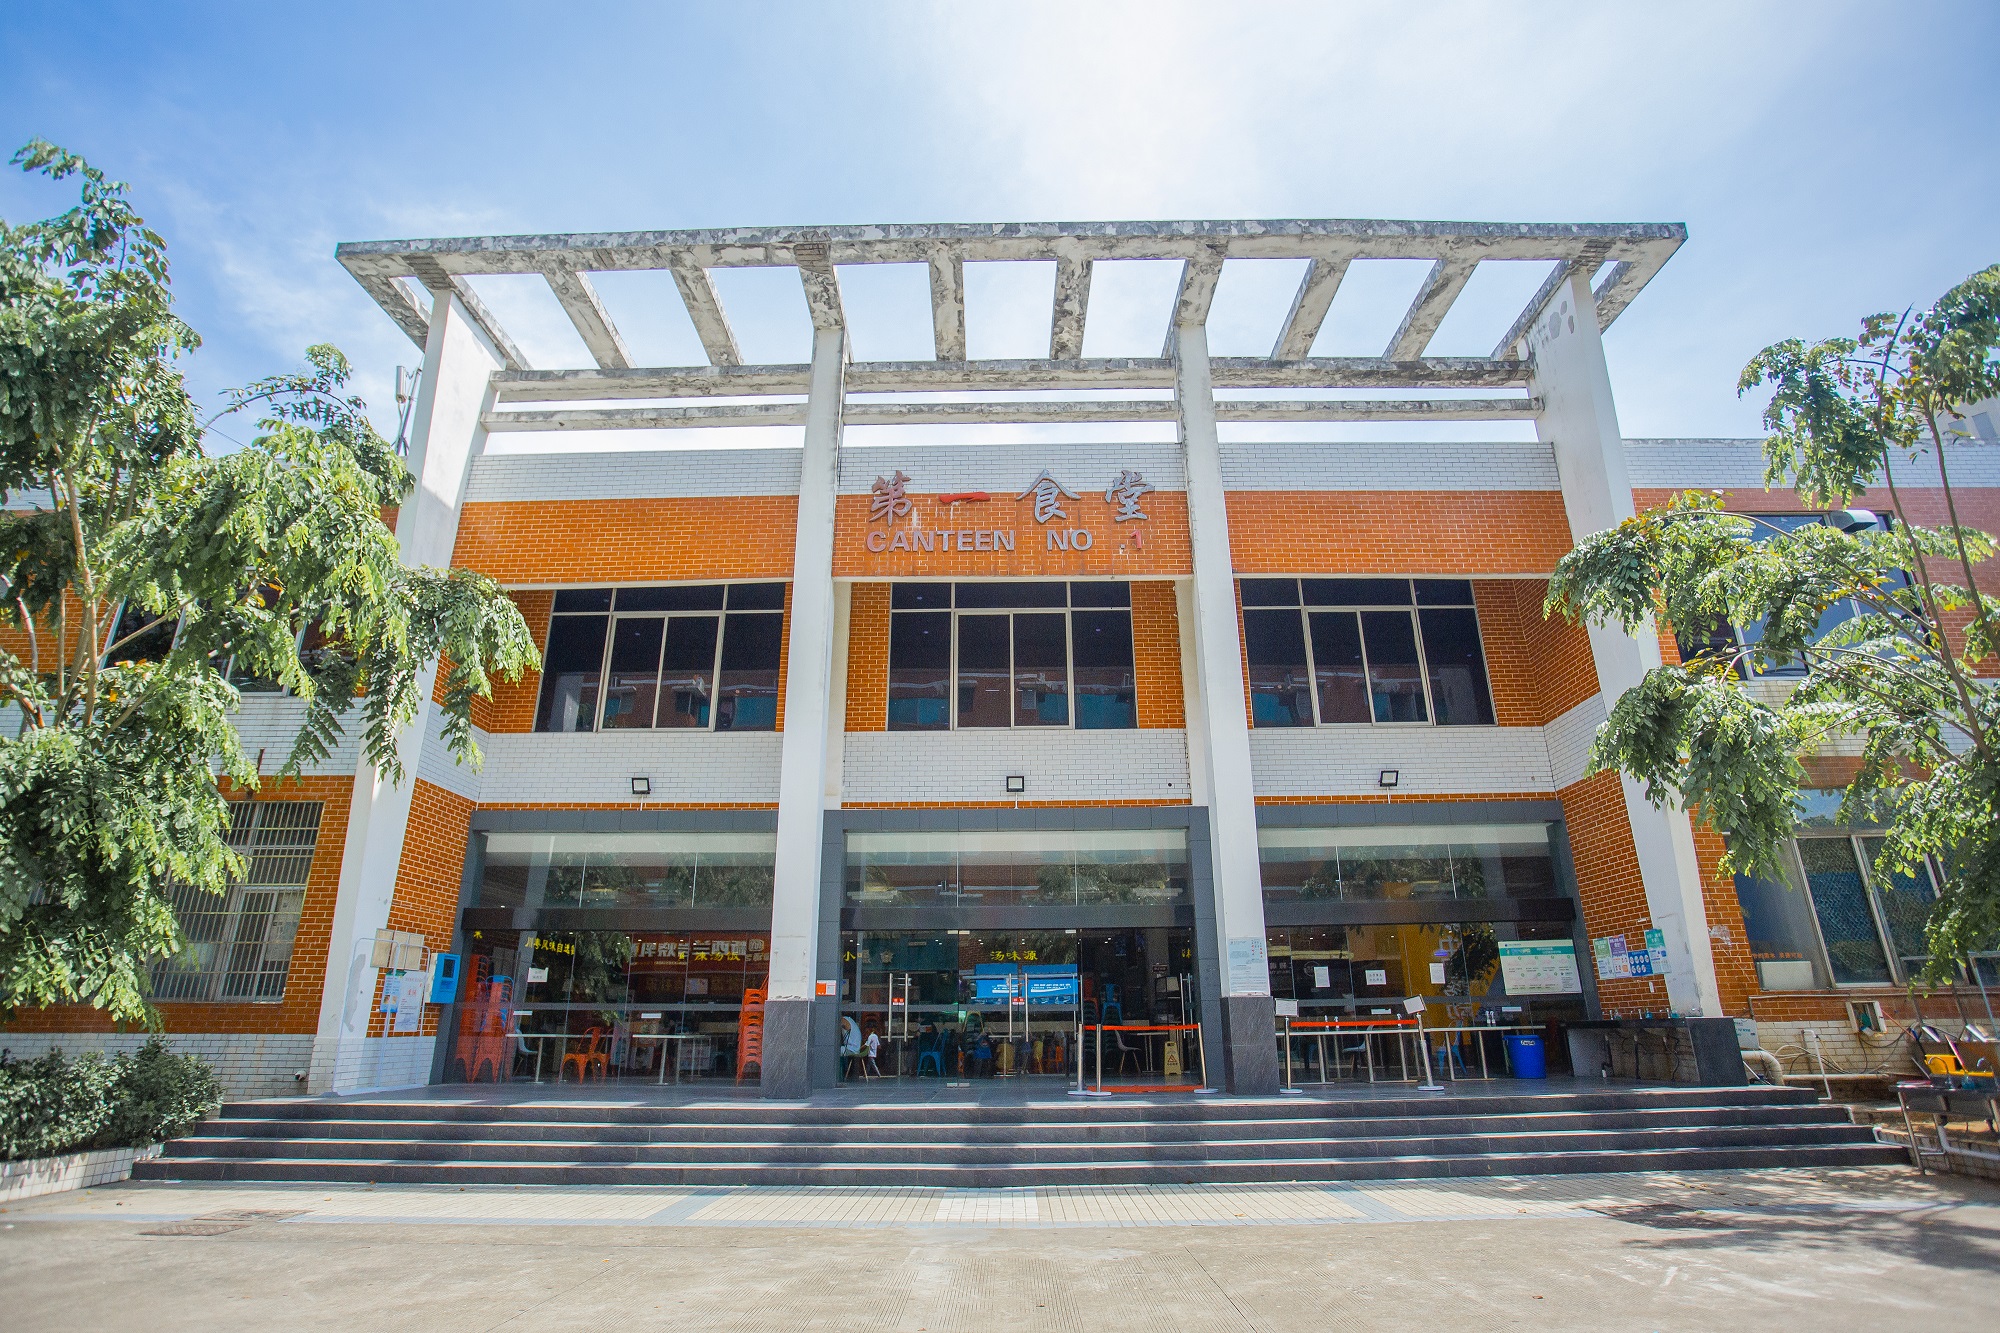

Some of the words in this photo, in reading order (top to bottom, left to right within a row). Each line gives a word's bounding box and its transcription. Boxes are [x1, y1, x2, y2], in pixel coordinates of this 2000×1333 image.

[868, 468, 1154, 527] 第一食堂
[866, 529, 1015, 552] CANTEEN
[1046, 529, 1093, 551] NO
